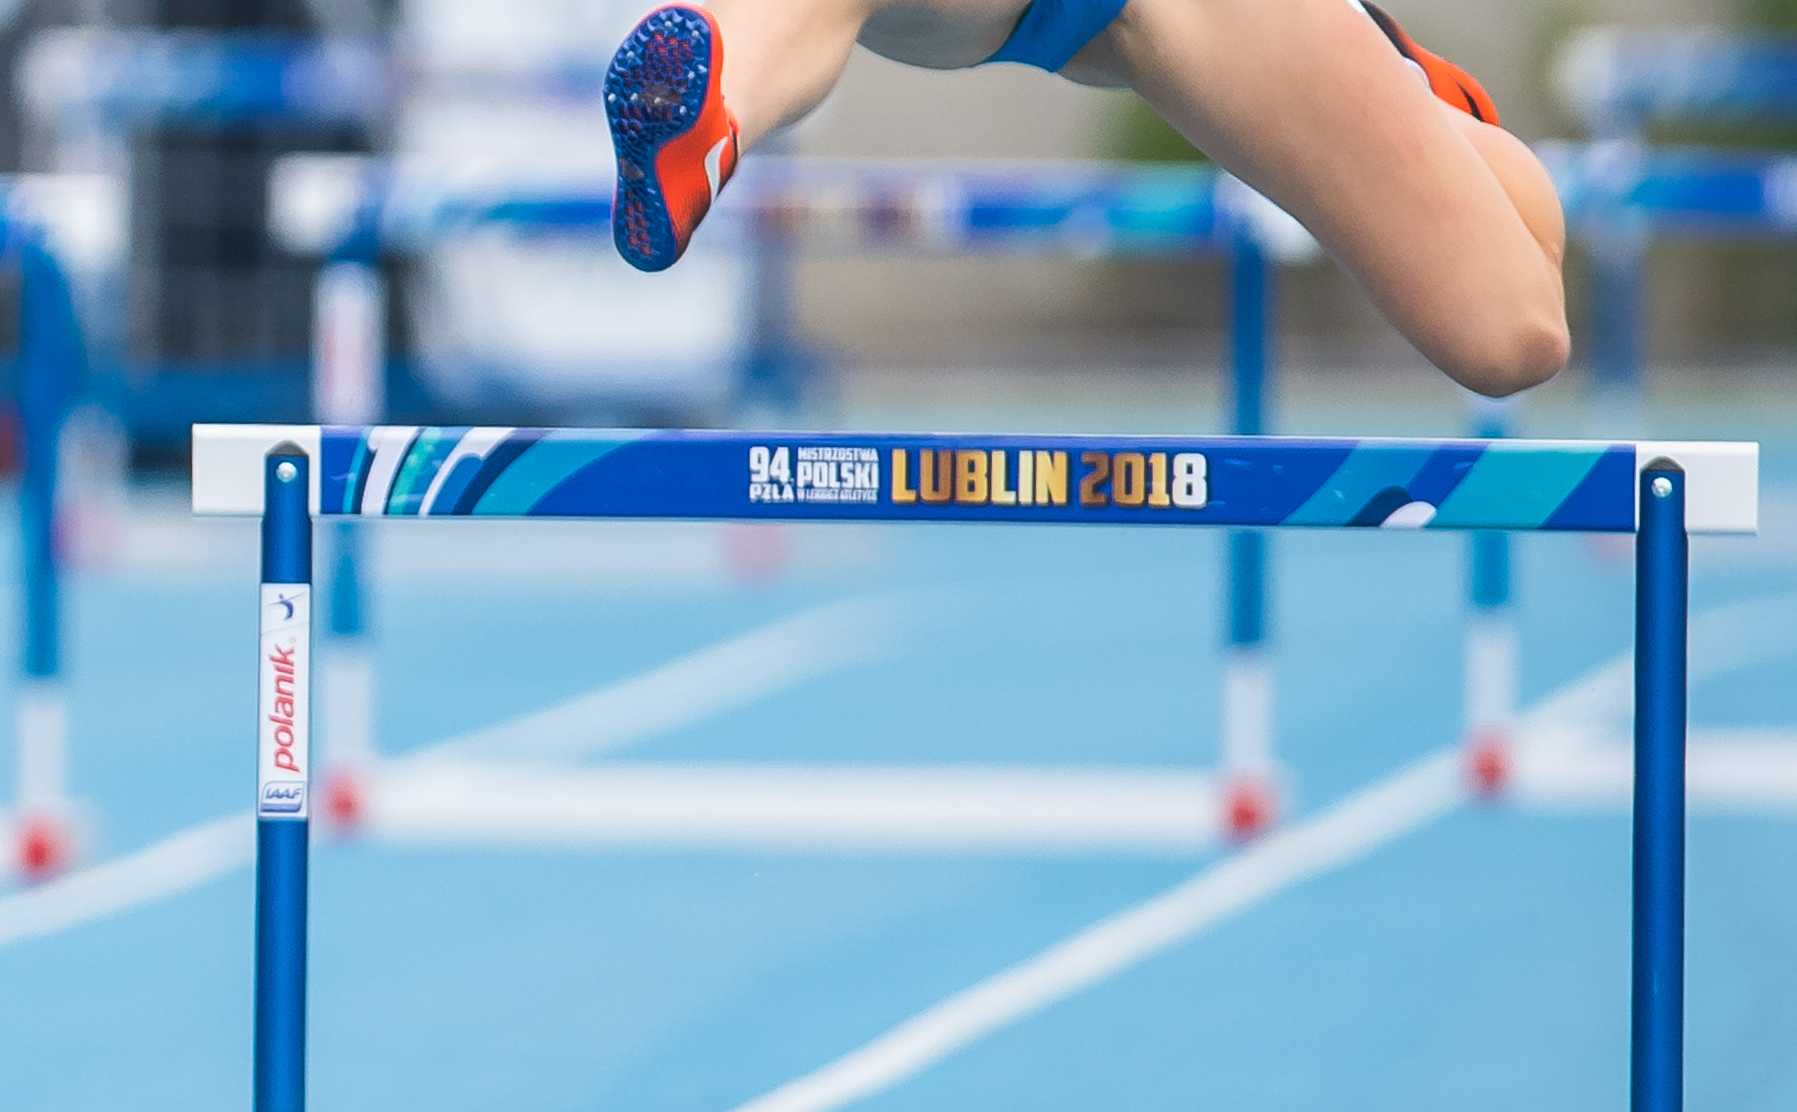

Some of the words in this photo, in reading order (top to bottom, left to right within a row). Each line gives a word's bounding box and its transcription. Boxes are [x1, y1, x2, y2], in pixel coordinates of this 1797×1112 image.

[796, 461, 880, 489] POLSKI
[891, 447, 1069, 506] LUBLIN
[1079, 451, 1208, 509] 2018
[749, 483, 795, 501] PZLA
[269, 643, 300, 773] polanik
[265, 787, 301, 800] IAAF
